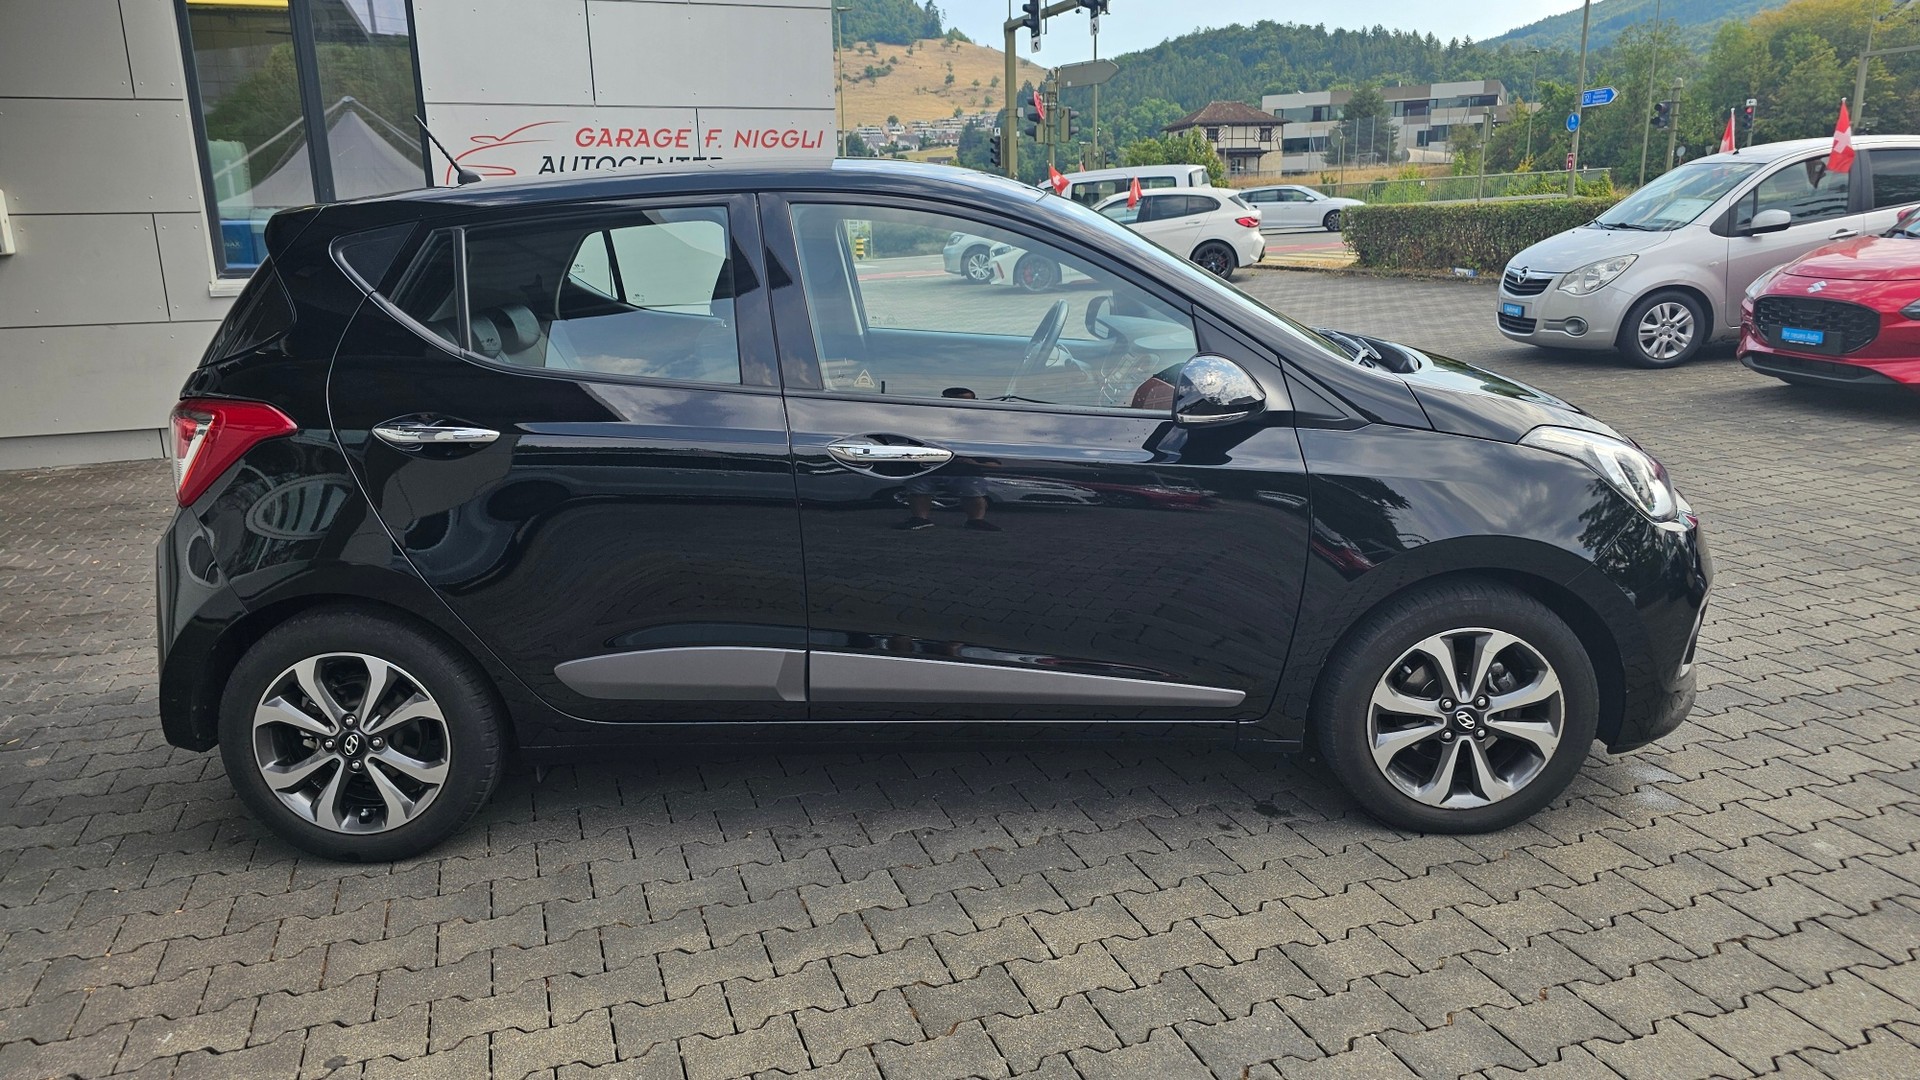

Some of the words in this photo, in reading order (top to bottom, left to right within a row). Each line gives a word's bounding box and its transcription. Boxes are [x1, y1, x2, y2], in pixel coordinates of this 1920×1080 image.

[575, 127, 692, 148] GARAGE
[705, 128, 722, 148] F.
[733, 129, 824, 149] NIGGLI
